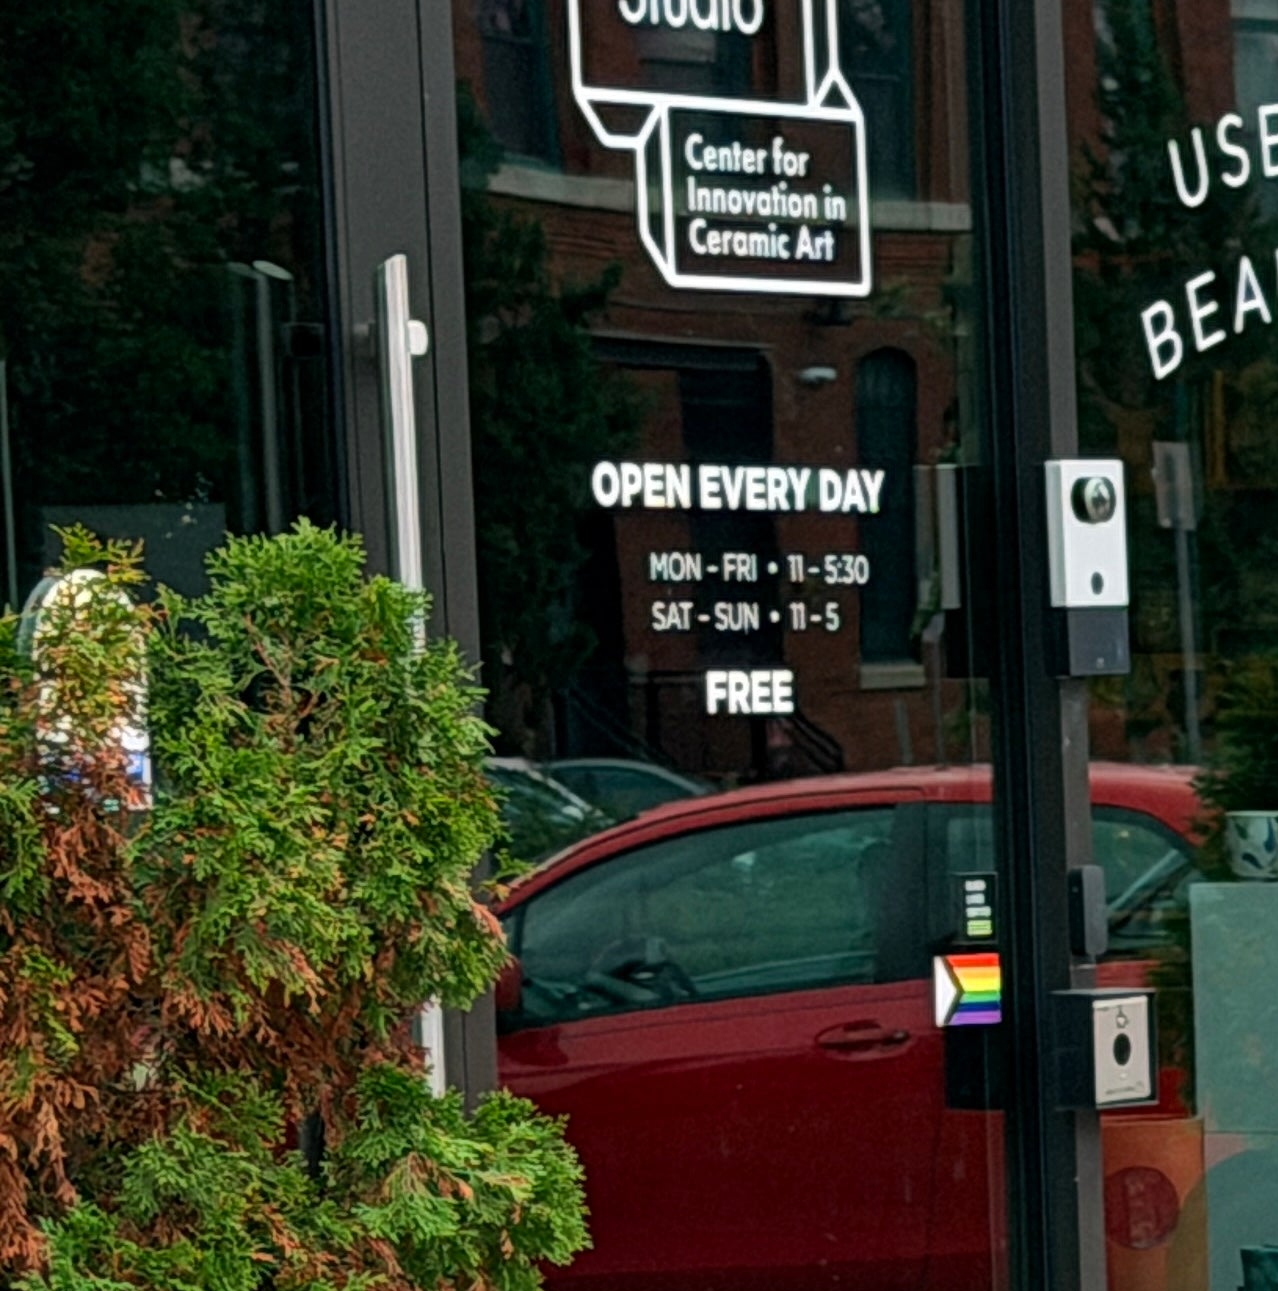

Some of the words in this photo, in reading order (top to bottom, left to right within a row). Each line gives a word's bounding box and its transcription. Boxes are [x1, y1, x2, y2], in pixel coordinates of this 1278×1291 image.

[685, 132, 768, 175] Center
[771, 136, 811, 177] for
[687, 176, 819, 220] Innovation
[822, 184, 847, 221] in
[688, 218, 791, 260] Ceramic
[794, 224, 835, 261] Art
[592, 461, 692, 509] OPEN
[699, 464, 812, 511] EVERY
[818, 468, 886, 513] DAY
[649, 551, 702, 582] MON
[722, 552, 758, 582] FRI
[651, 602, 694, 631] SAT
[714, 602, 760, 632] SUN
[705, 669, 794, 715] FREE
